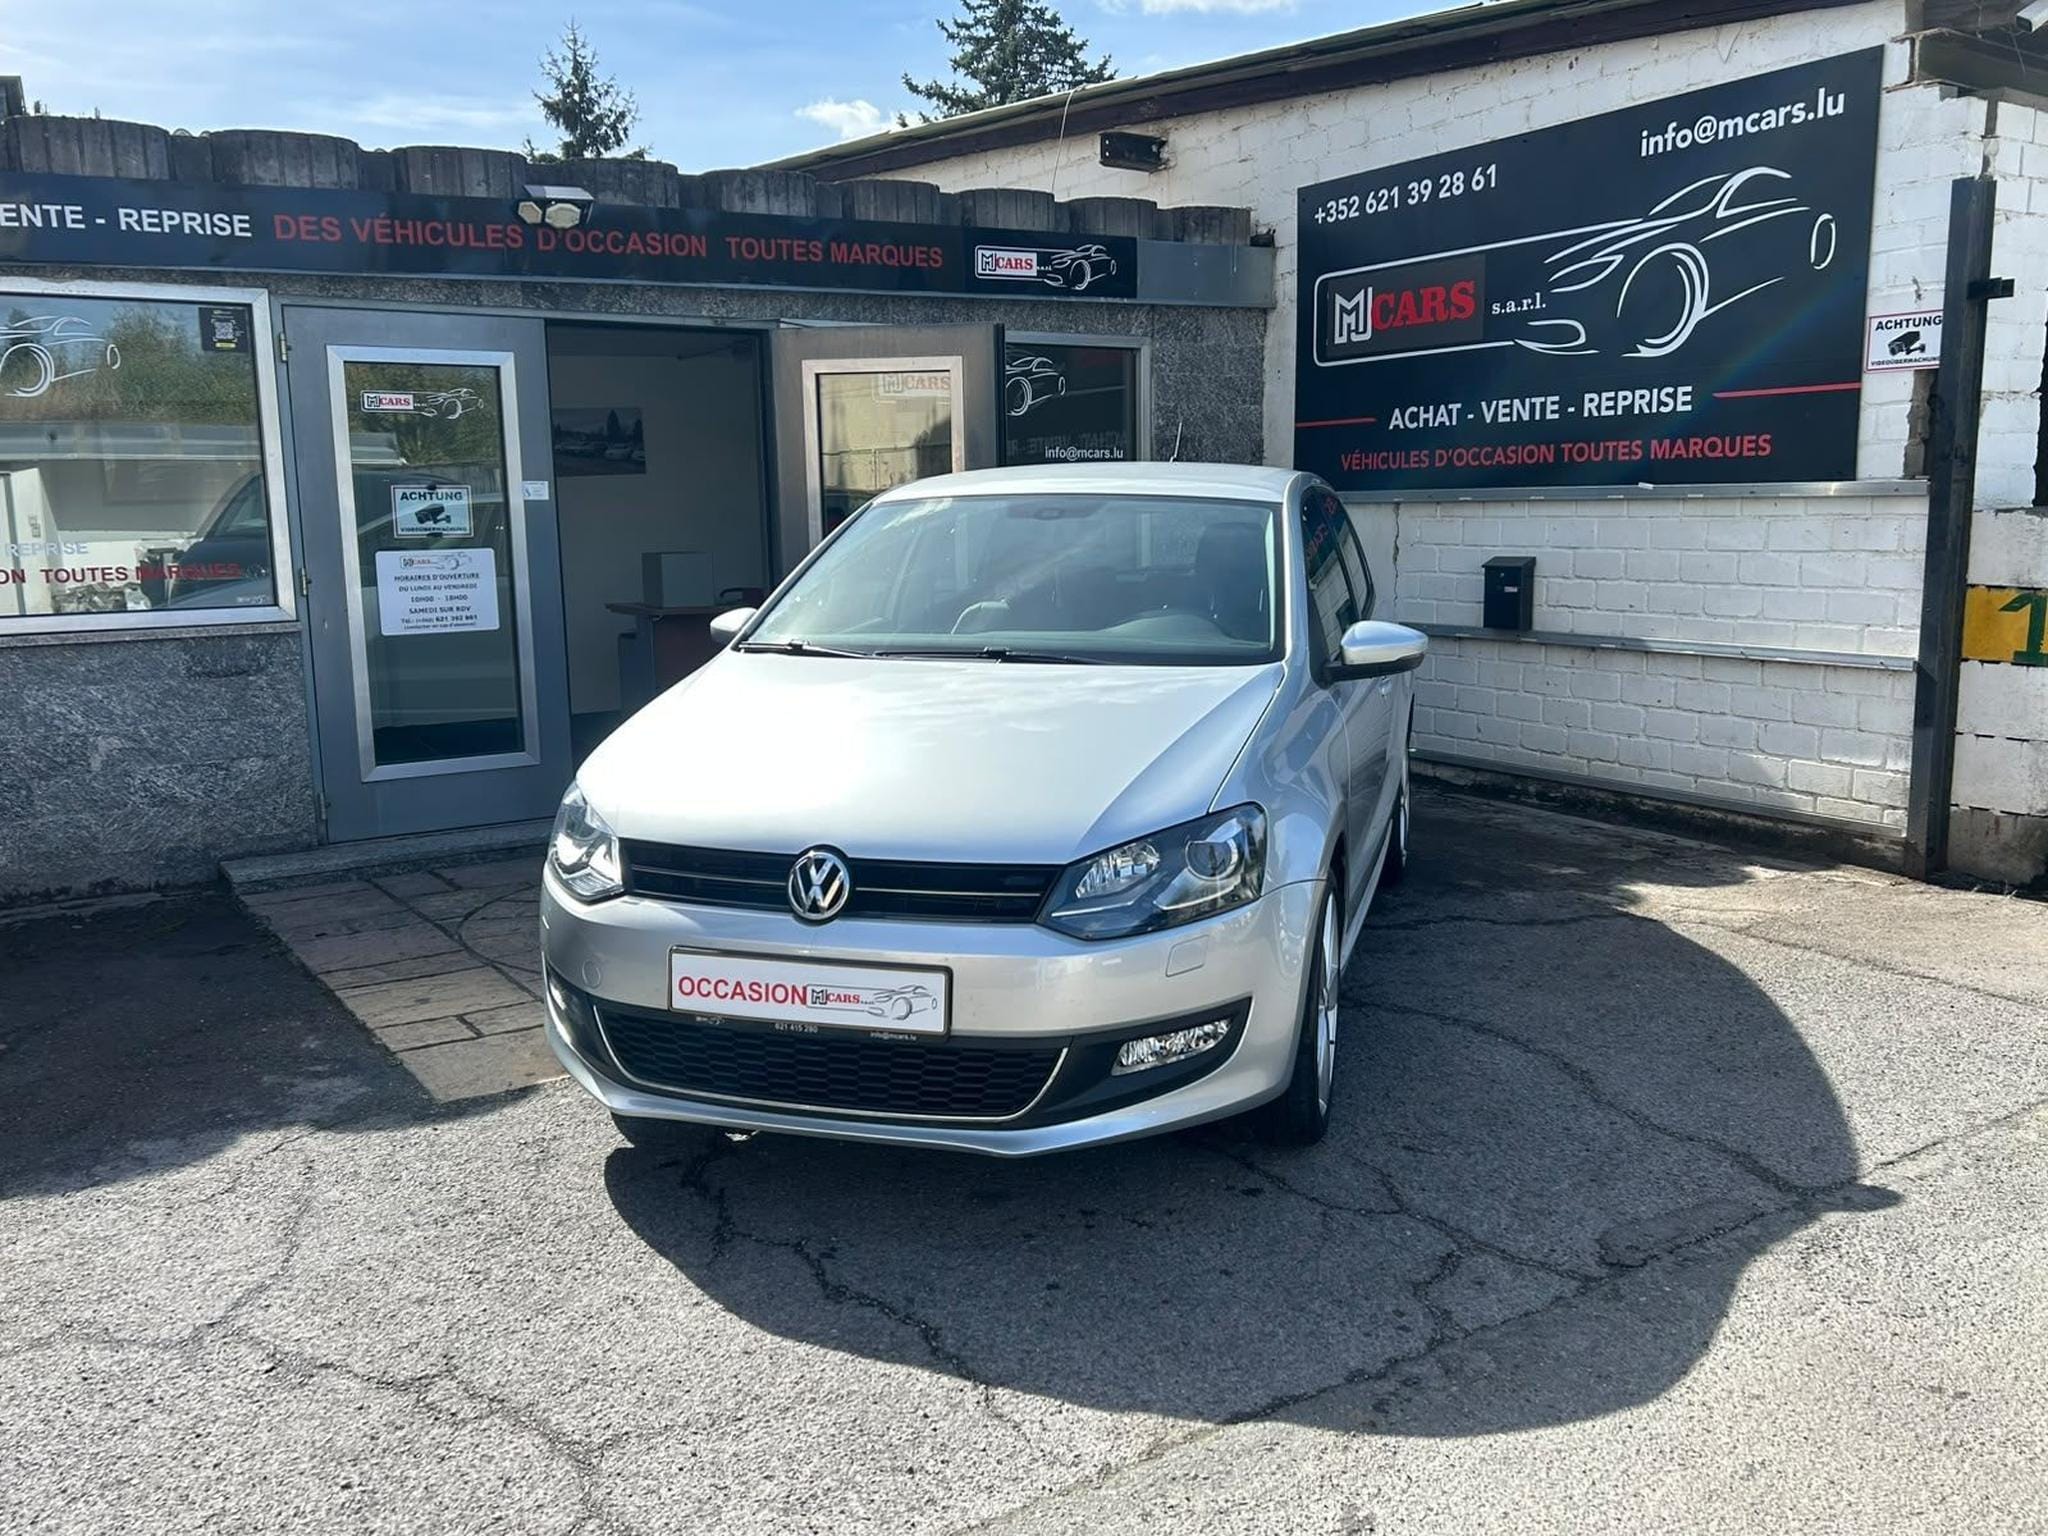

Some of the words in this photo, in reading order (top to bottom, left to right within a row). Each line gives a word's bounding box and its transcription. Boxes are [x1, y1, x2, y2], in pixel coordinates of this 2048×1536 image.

[1640, 87, 1846, 157] info@mcars.lu
[1315, 195, 1360, 224] +352
[1365, 186, 1399, 214] 621
[1407, 179, 1432, 205] 39
[1438, 172, 1465, 199] 28
[1471, 163, 1497, 191] 61
[118, 207, 252, 237] REPRISE
[273, 214, 342, 241] DES
[351, 211, 523, 248] VÉHICULES
[537, 229, 707, 257] D'OCCASION
[725, 236, 824, 262] TOUTES
[830, 241, 943, 268] MARQUES
[1491, 292, 1547, 315] s.a.r.l.
[1875, 314, 1942, 331] ACHTUNG
[1388, 403, 1462, 430] ACHAT
[1480, 396, 1560, 424] VENTE
[1583, 386, 1693, 417] REPRISE
[1044, 446, 1124, 461] info@mcars.lu
[1341, 449, 1430, 471] VÉHICULES
[1434, 444, 1555, 467] D'OCCASION
[1561, 440, 1643, 463] TOUTES
[1650, 434, 1772, 460] MARQUES
[400, 491, 463, 501] ACHTUNG
[6, 541, 89, 557] REPRISE
[40, 566, 128, 584] TOUTES
[136, 563, 242, 581] MARQUES
[678, 976, 807, 1006] OCCASION
